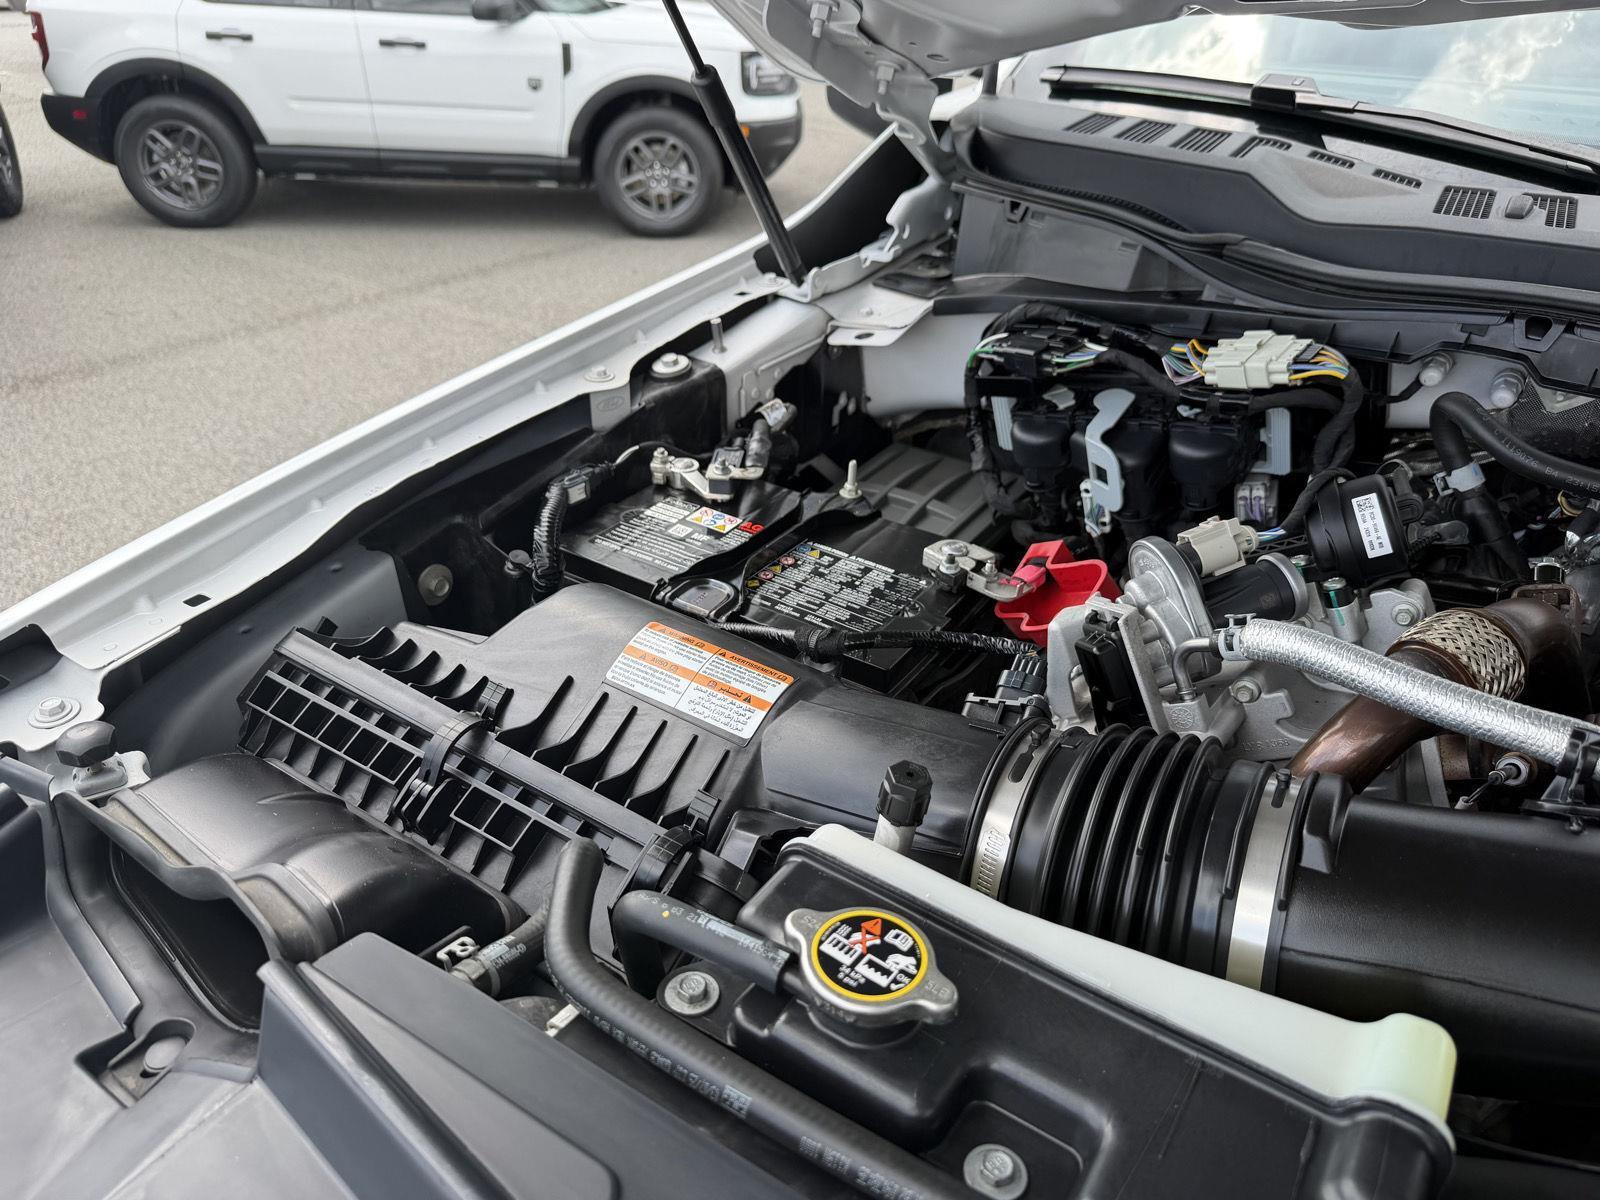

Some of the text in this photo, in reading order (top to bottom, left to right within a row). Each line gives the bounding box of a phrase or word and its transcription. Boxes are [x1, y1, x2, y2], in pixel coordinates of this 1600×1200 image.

[650, 656, 668, 667] AVISO
[728, 655, 778, 676] AVERTISSEMENT
[843, 976, 858, 987] psi
[896, 974, 912, 984] OK
